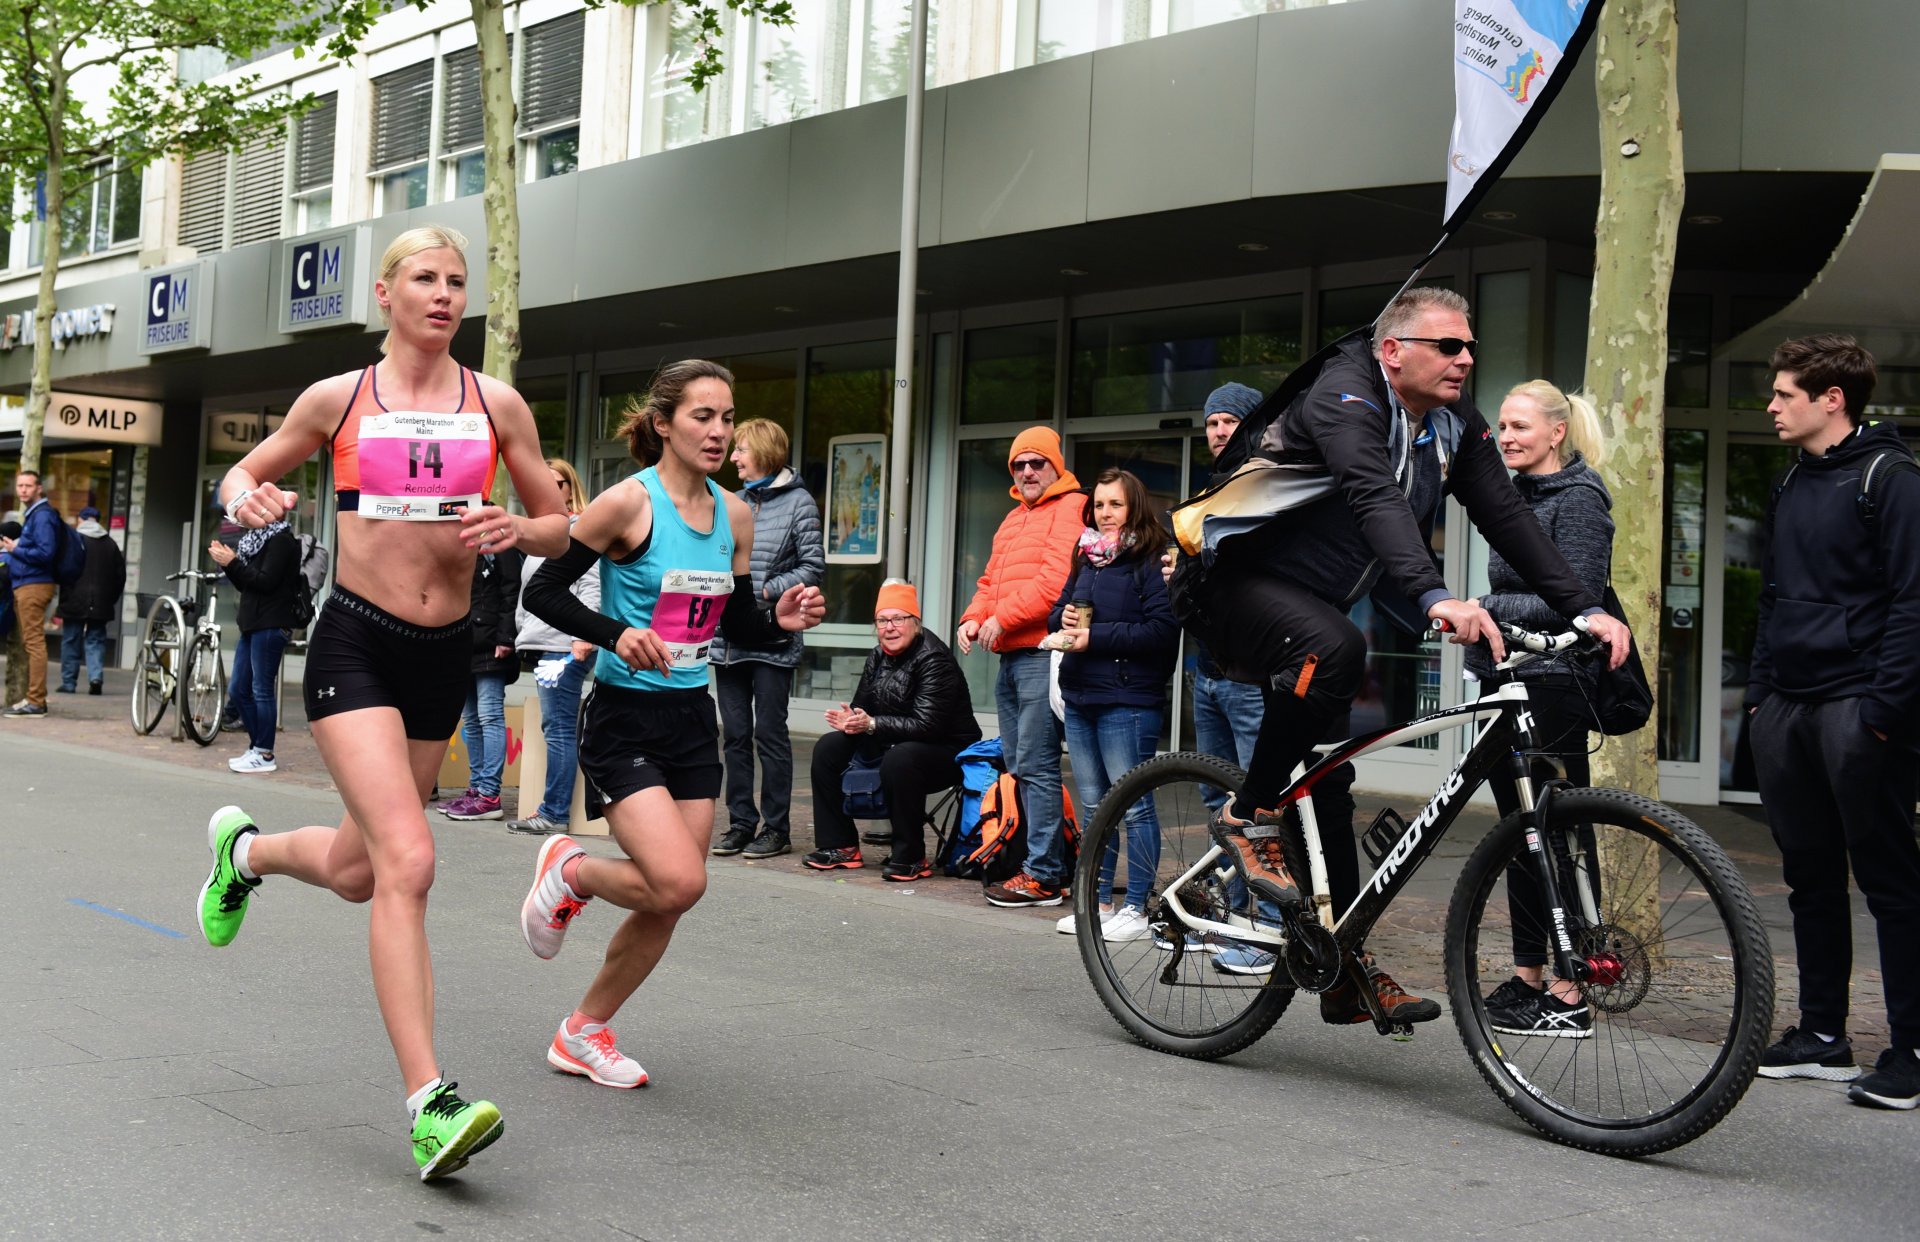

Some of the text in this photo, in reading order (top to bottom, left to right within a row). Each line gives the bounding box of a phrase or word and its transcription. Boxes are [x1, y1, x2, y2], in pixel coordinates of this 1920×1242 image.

[291, 294, 342, 321] FRISEURE
[21, 303, 116, 350] Mpower
[147, 321, 189, 344] FRISEURE
[88, 408, 137, 430] MLP
[394, 416, 455, 427] Gutenberg Marathon
[416, 426, 434, 435] Mainz
[409, 442, 443, 478] F4
[404, 483, 447, 494] Remalda
[356, 605, 403, 634] ARMOUR
[687, 596, 714, 629] F8
[1552, 907, 1573, 951] ROCKSHOX
